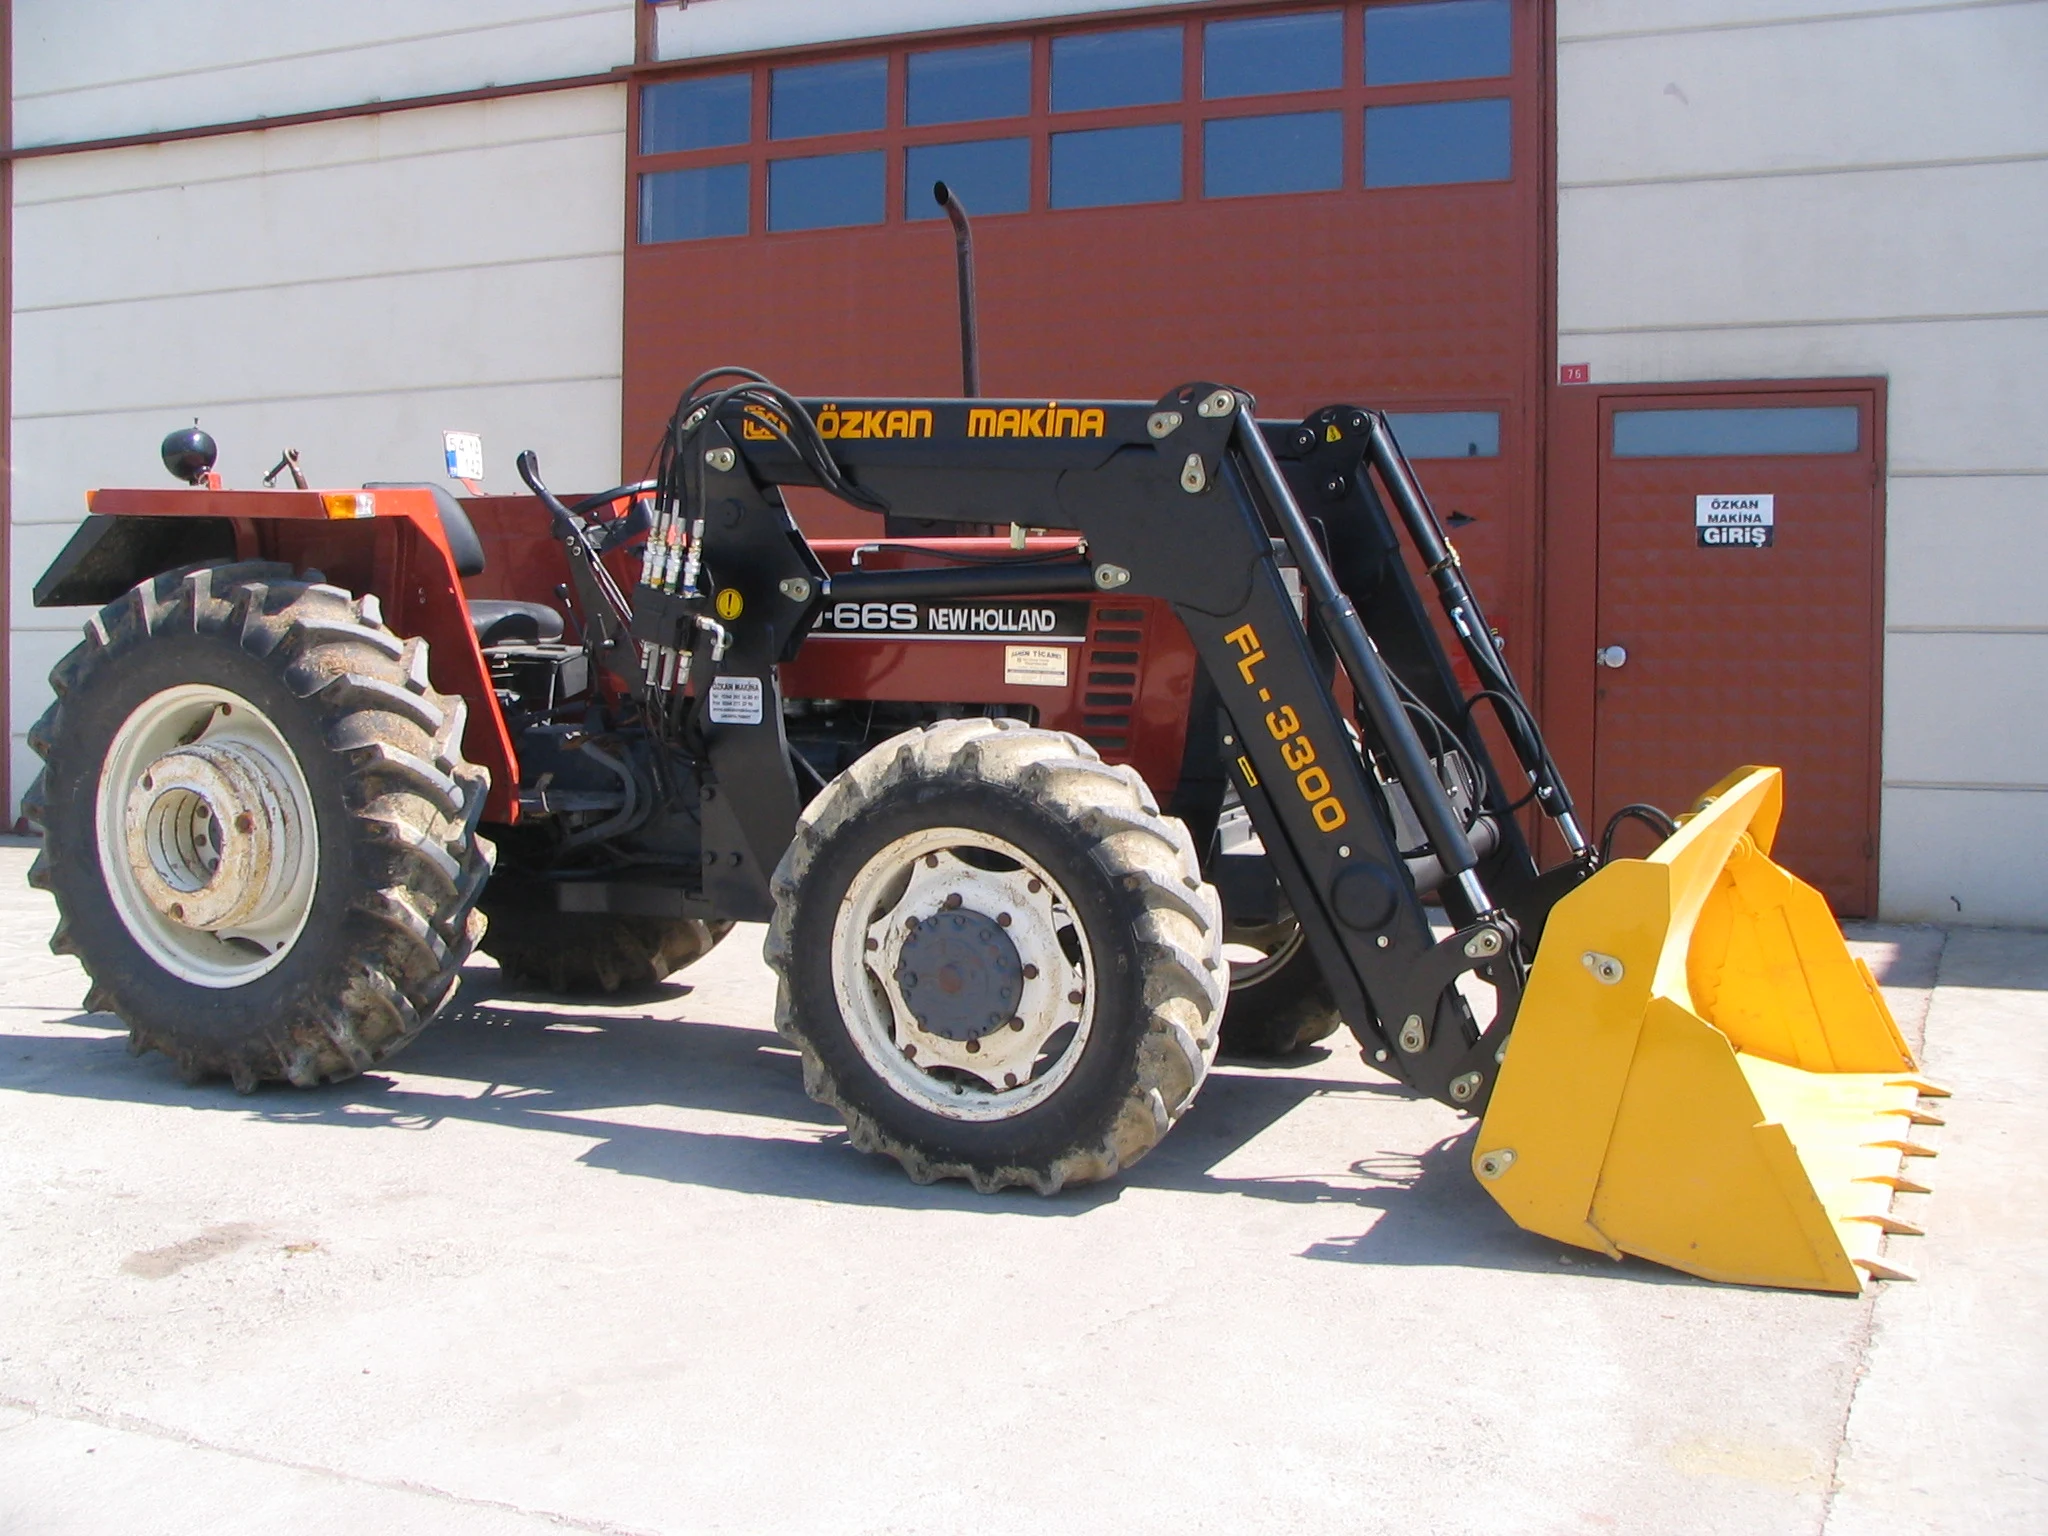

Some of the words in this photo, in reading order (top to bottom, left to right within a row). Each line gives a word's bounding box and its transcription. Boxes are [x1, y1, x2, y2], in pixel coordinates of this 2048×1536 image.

[1568, 369, 1581, 379] 76
[817, 403, 934, 439] ÖZKAN
[1711, 498, 1758, 509] ÖZKAN
[1708, 512, 1762, 523] MAKİNA
[928, 608, 970, 631] NEW
[971, 609, 1056, 632] HOLLAND
[1223, 624, 1347, 832] FL-3300
